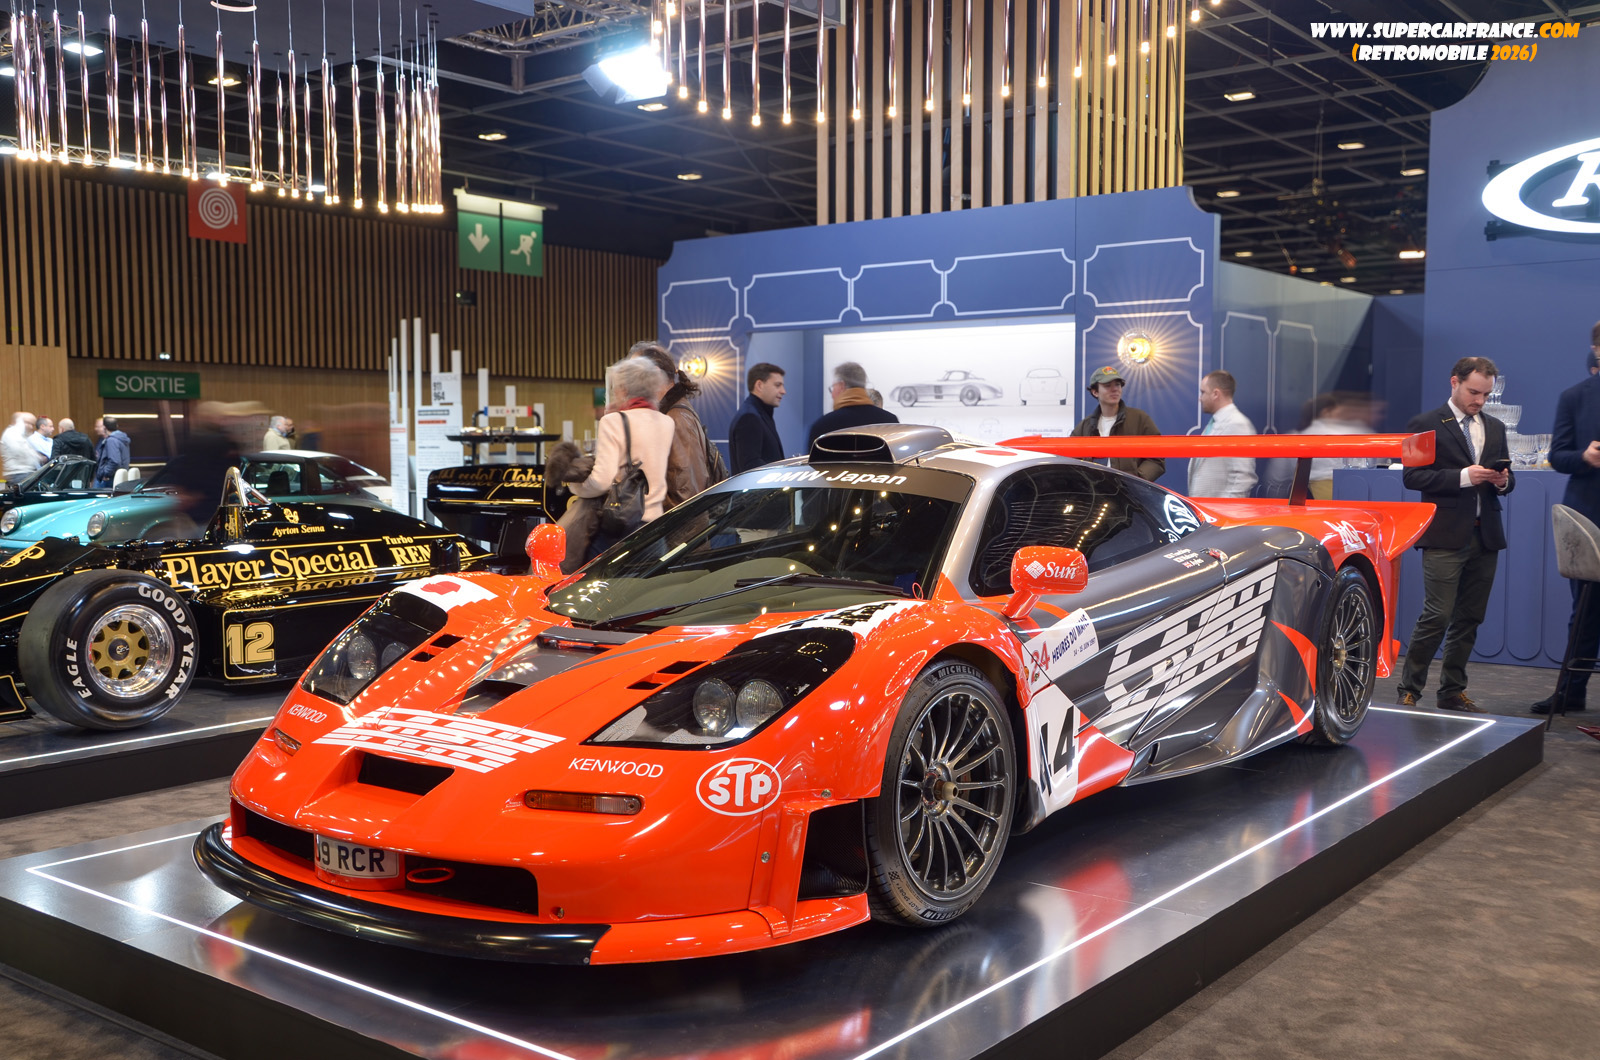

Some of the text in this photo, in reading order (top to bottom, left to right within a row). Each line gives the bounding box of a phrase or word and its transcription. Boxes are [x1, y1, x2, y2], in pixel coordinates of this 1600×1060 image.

[115, 375, 186, 394] SORTIE
[757, 470, 907, 485] BMW Japan
[272, 524, 325, 538] Ayrton Senna
[382, 535, 414, 546] Turbo
[163, 543, 378, 590] Player Special
[1044, 561, 1078, 580] Sun
[226, 621, 275, 665] 12
[1031, 641, 1051, 685] 24
[1052, 635, 1071, 664] HEURES
[1068, 627, 1078, 645] DU
[66, 637, 93, 699] EAGLE
[937, 665, 982, 678] MICHELIN
[287, 703, 328, 724] KENWOOD
[568, 757, 664, 778] KENWOOD
[708, 763, 772, 807] STP
[337, 845, 385, 872] RCR
